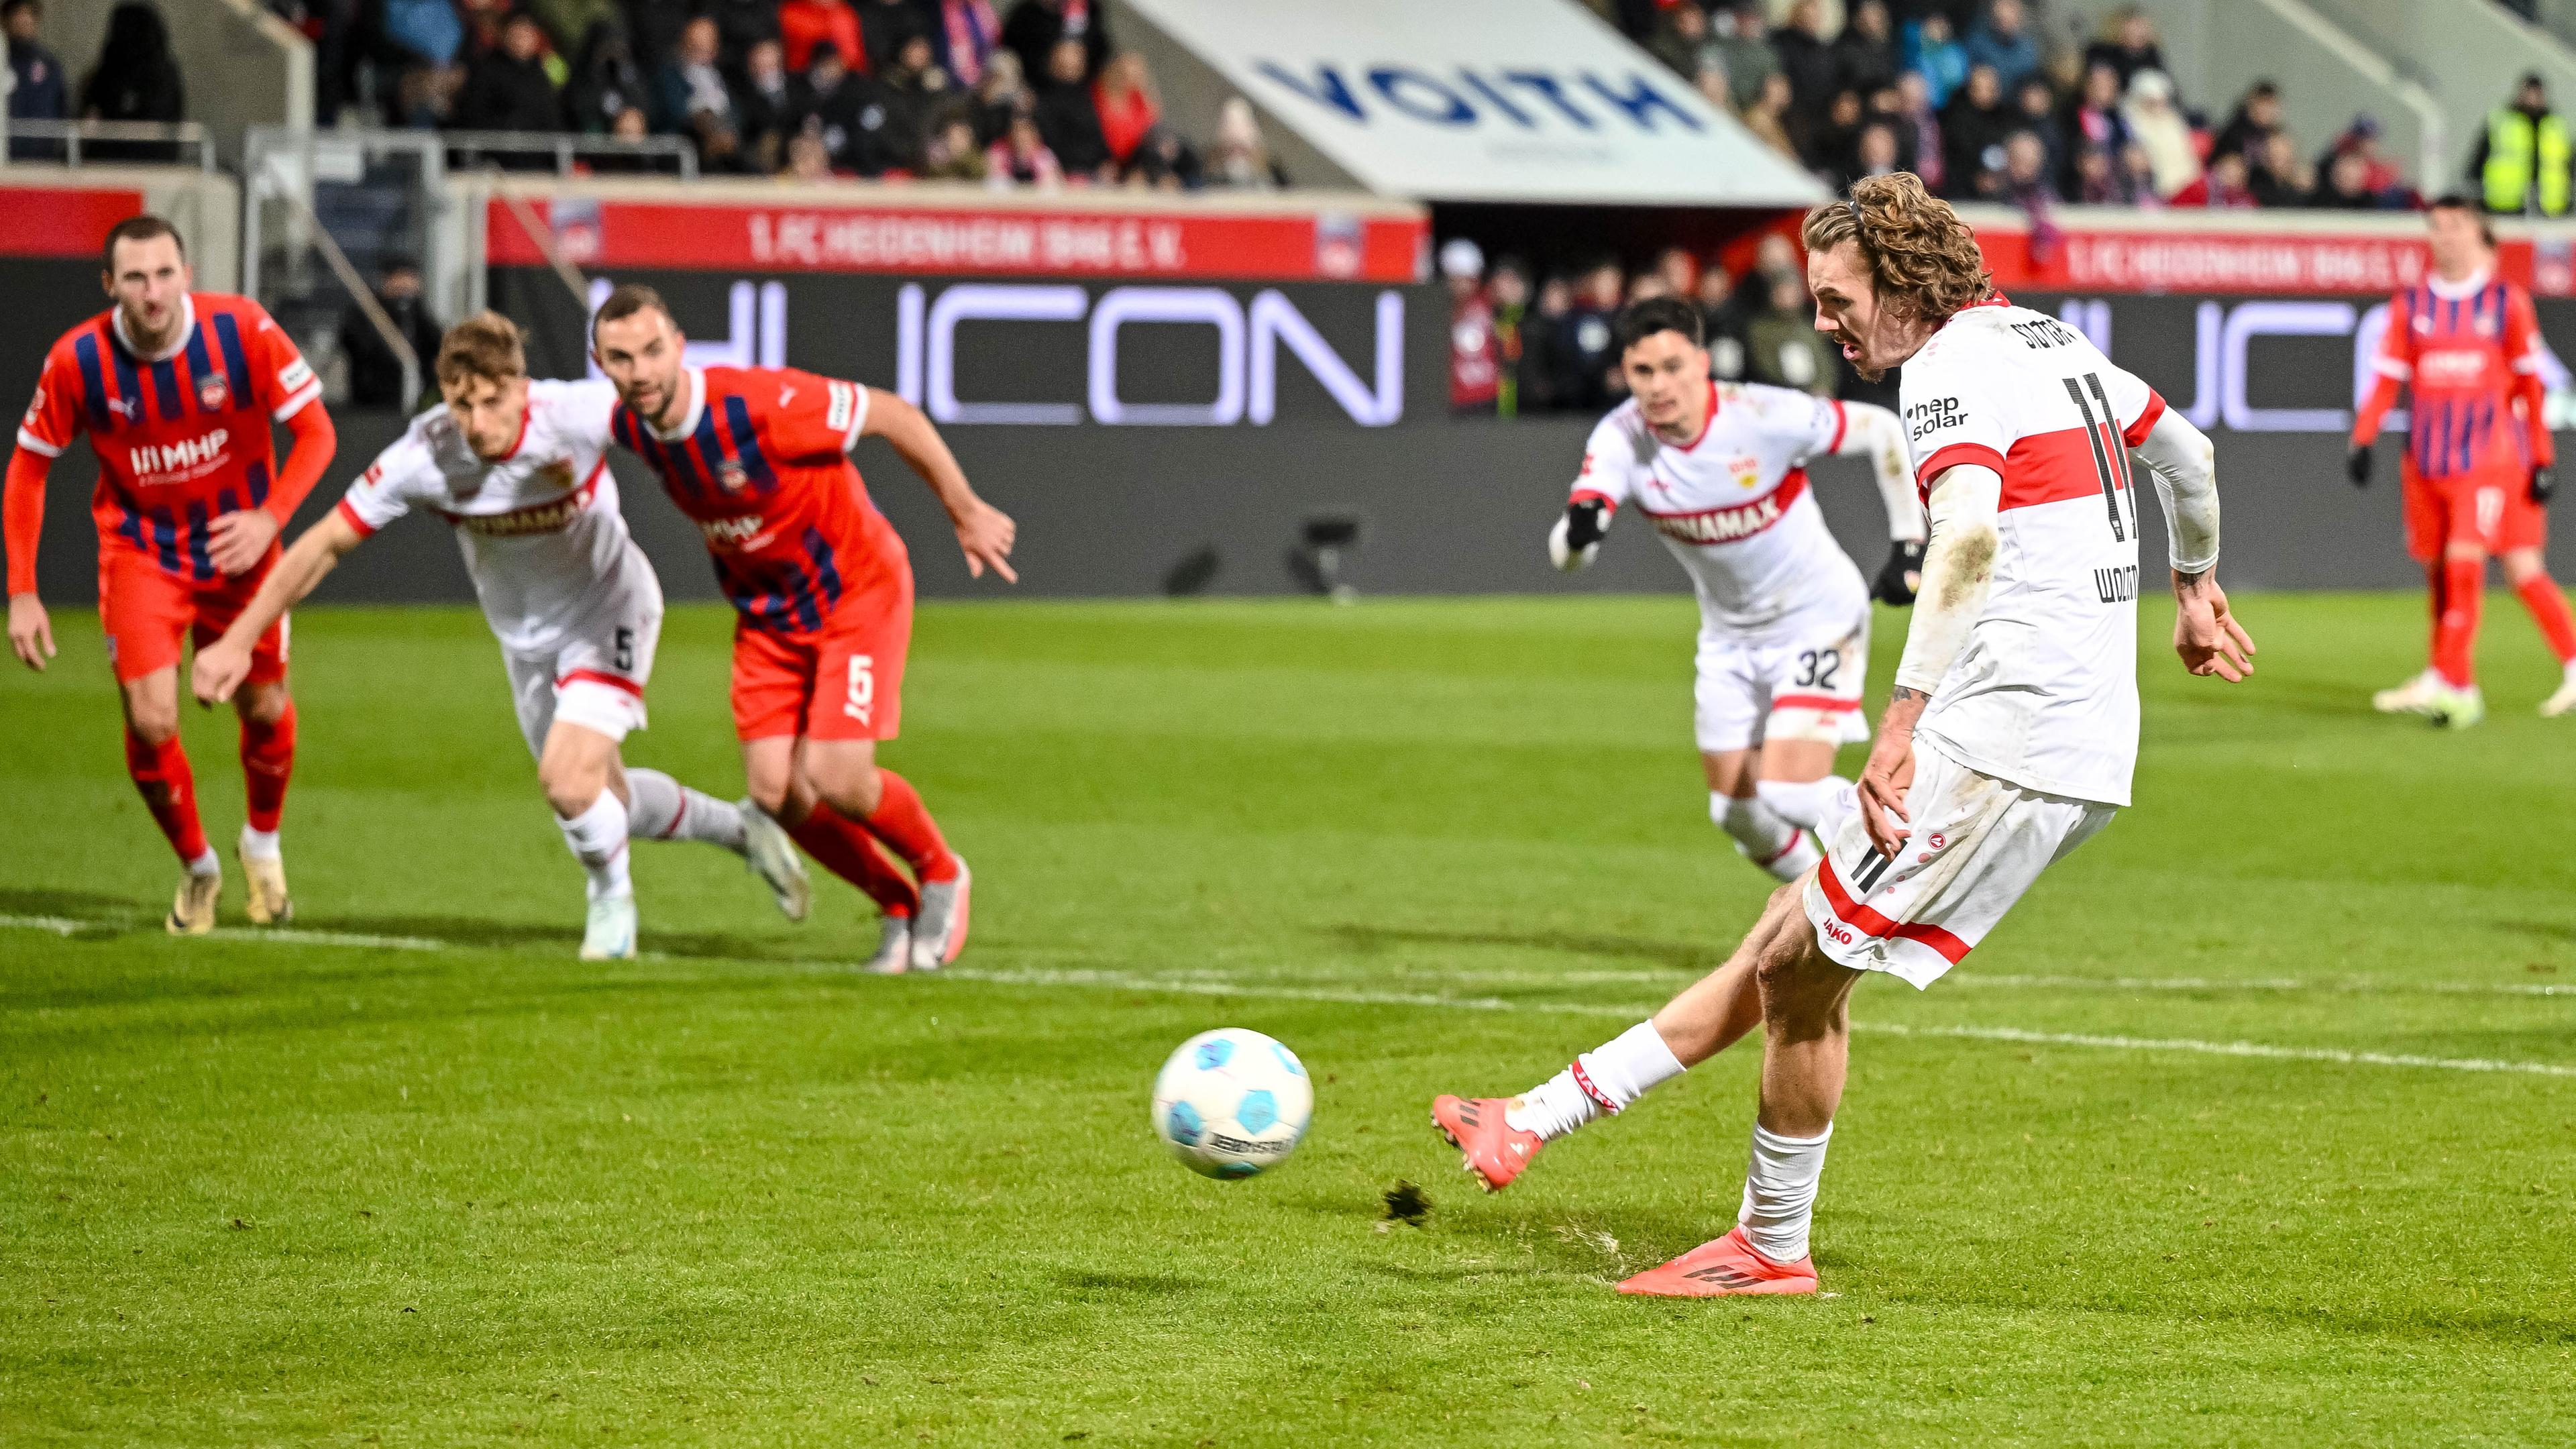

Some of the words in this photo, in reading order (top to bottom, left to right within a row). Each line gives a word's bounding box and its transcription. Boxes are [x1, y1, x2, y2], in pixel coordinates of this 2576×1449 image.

[1251, 59, 1707, 131] VOITH
[1913, 413, 1968, 441] solar
[1916, 397, 1959, 421] hep
[161, 428, 229, 472] MHP
[2062, 372, 2137, 542] 11
[614, 626, 633, 671] 5
[1795, 648, 1839, 690] 32
[848, 654, 873, 704] 5
[1823, 917, 1852, 945] JAKO
